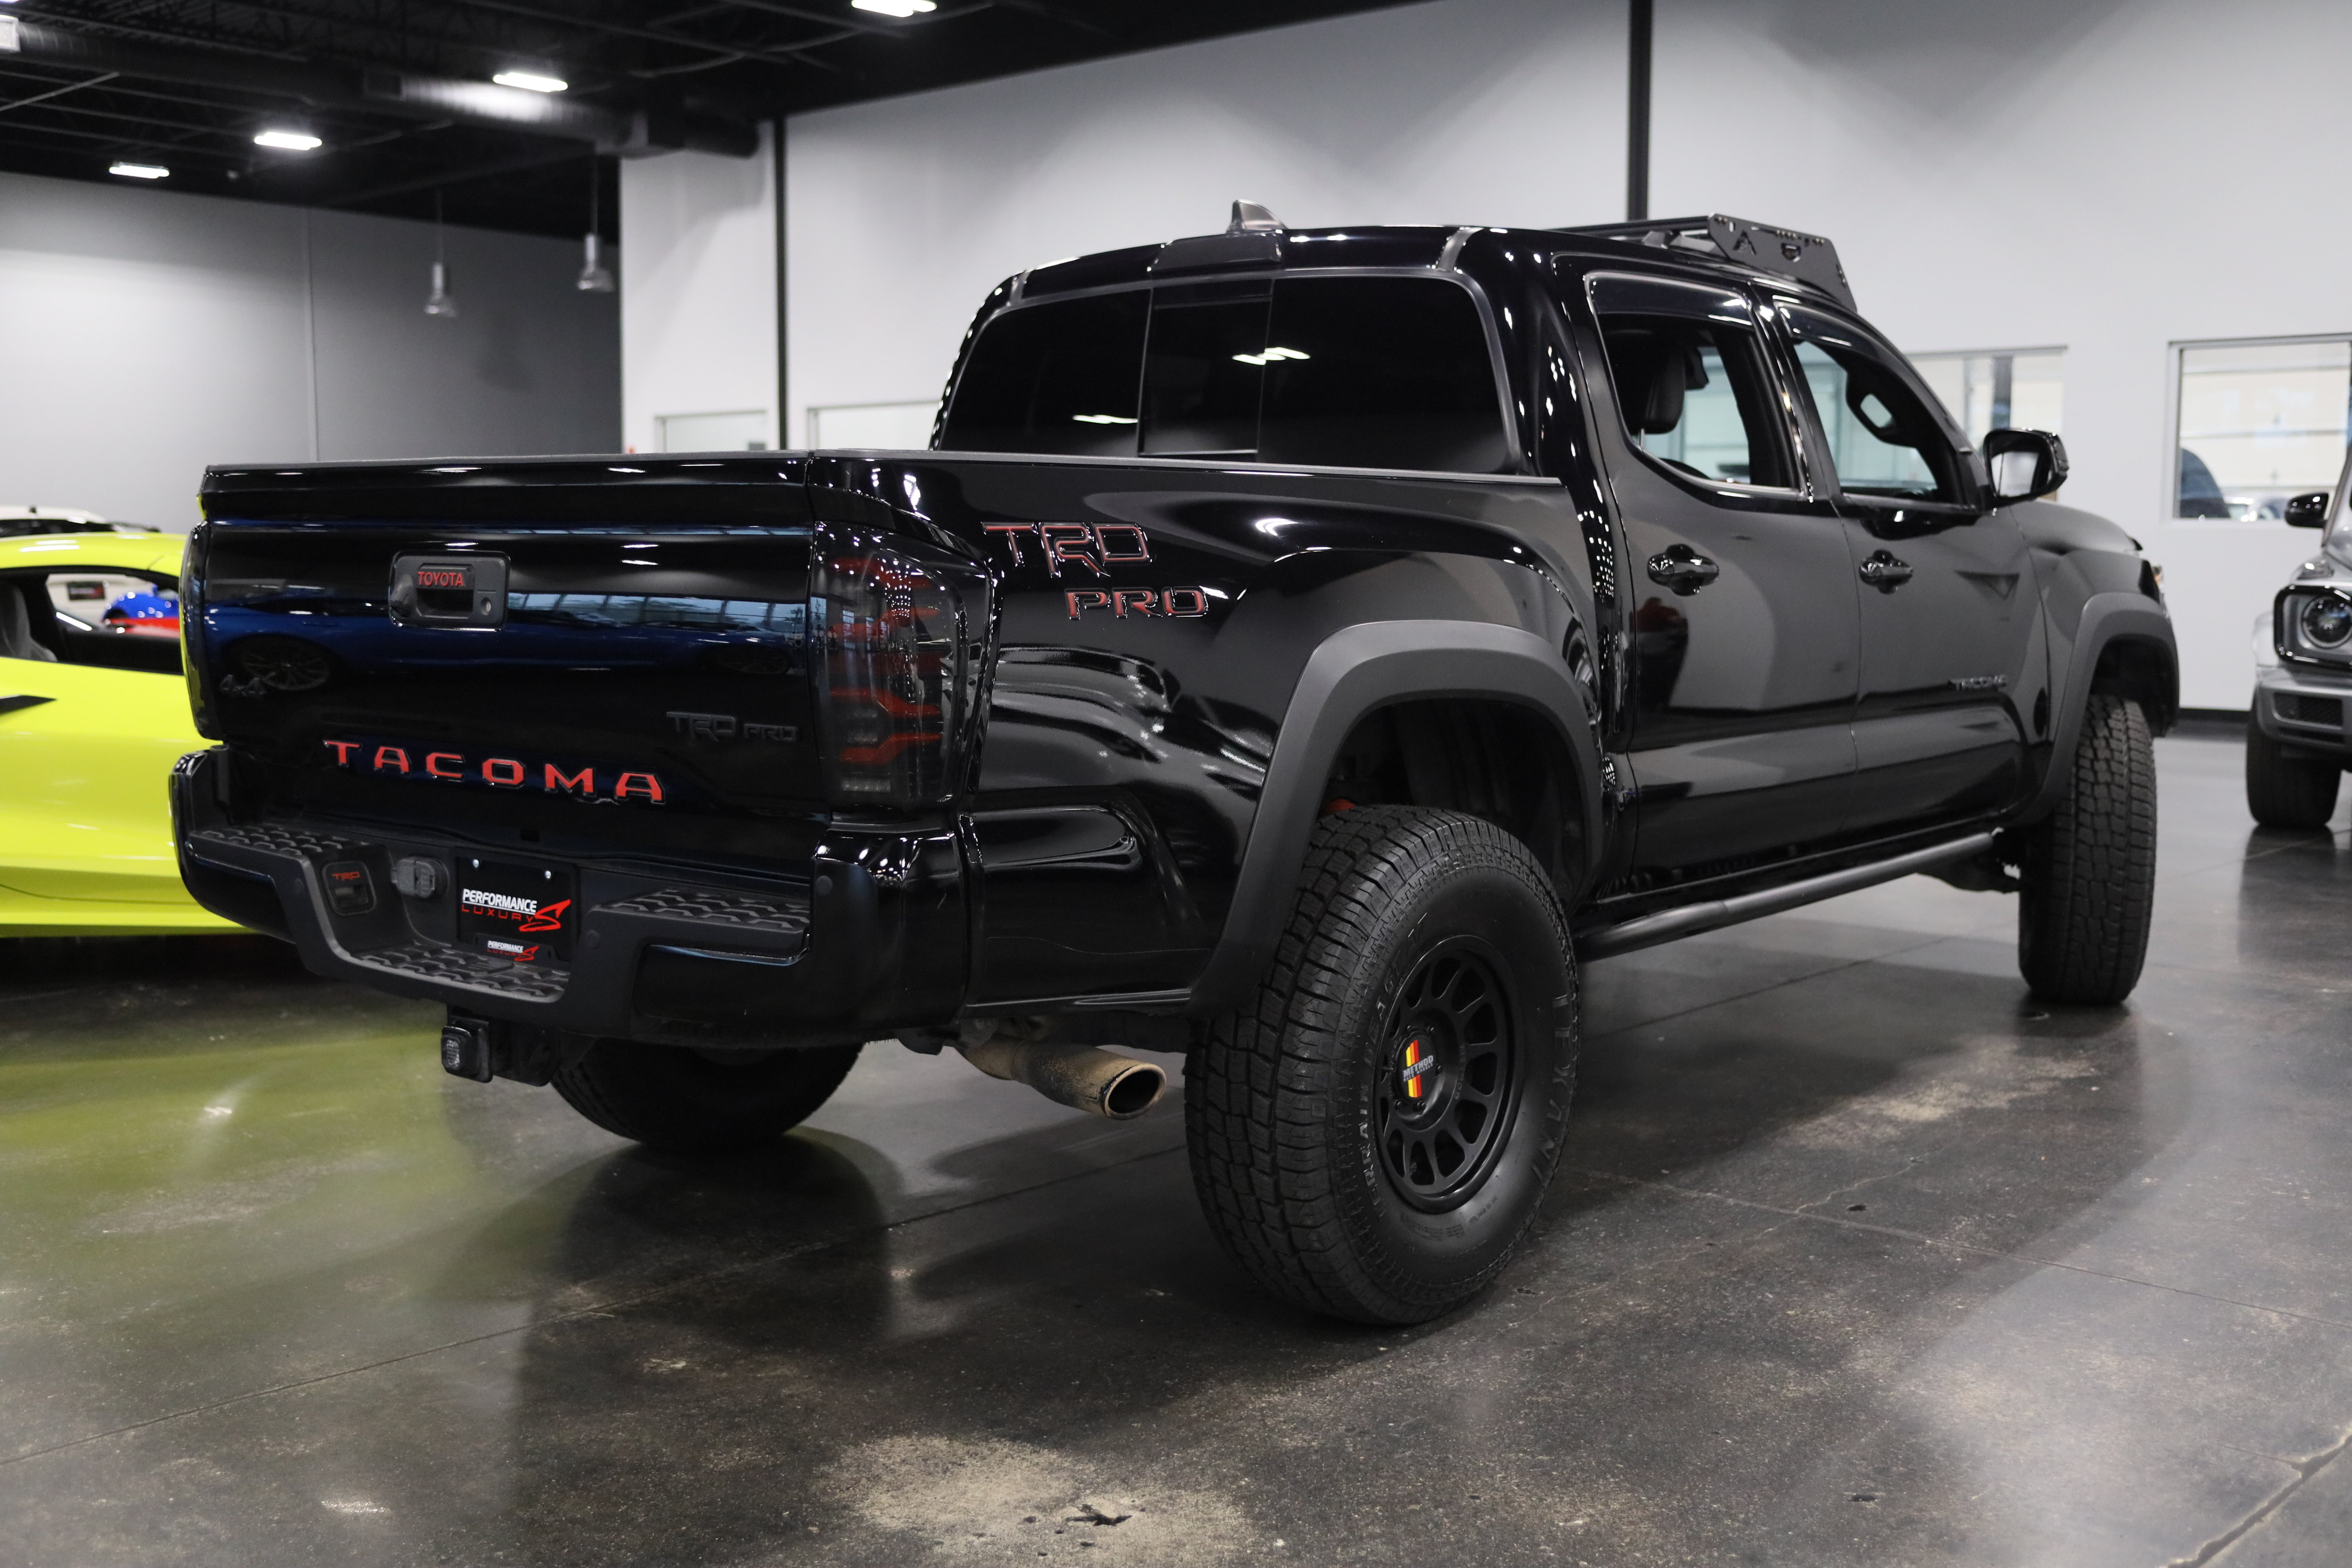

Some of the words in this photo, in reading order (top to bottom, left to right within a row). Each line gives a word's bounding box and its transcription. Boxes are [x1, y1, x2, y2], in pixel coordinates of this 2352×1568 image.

[981, 522, 1152, 578] TRD
[418, 571, 466, 587] TOYOTA
[1065, 586, 1209, 620] PRO
[666, 712, 736, 742] TRD
[744, 723, 797, 742] PRO
[324, 740, 666, 804] TACOMA
[332, 871, 360, 882] TRD
[462, 888, 538, 913] PERFORMANCE
[461, 904, 534, 923] LUXURY
[488, 940, 524, 952] PERFORMANCE
[1403, 1055, 1434, 1078] METHOD
